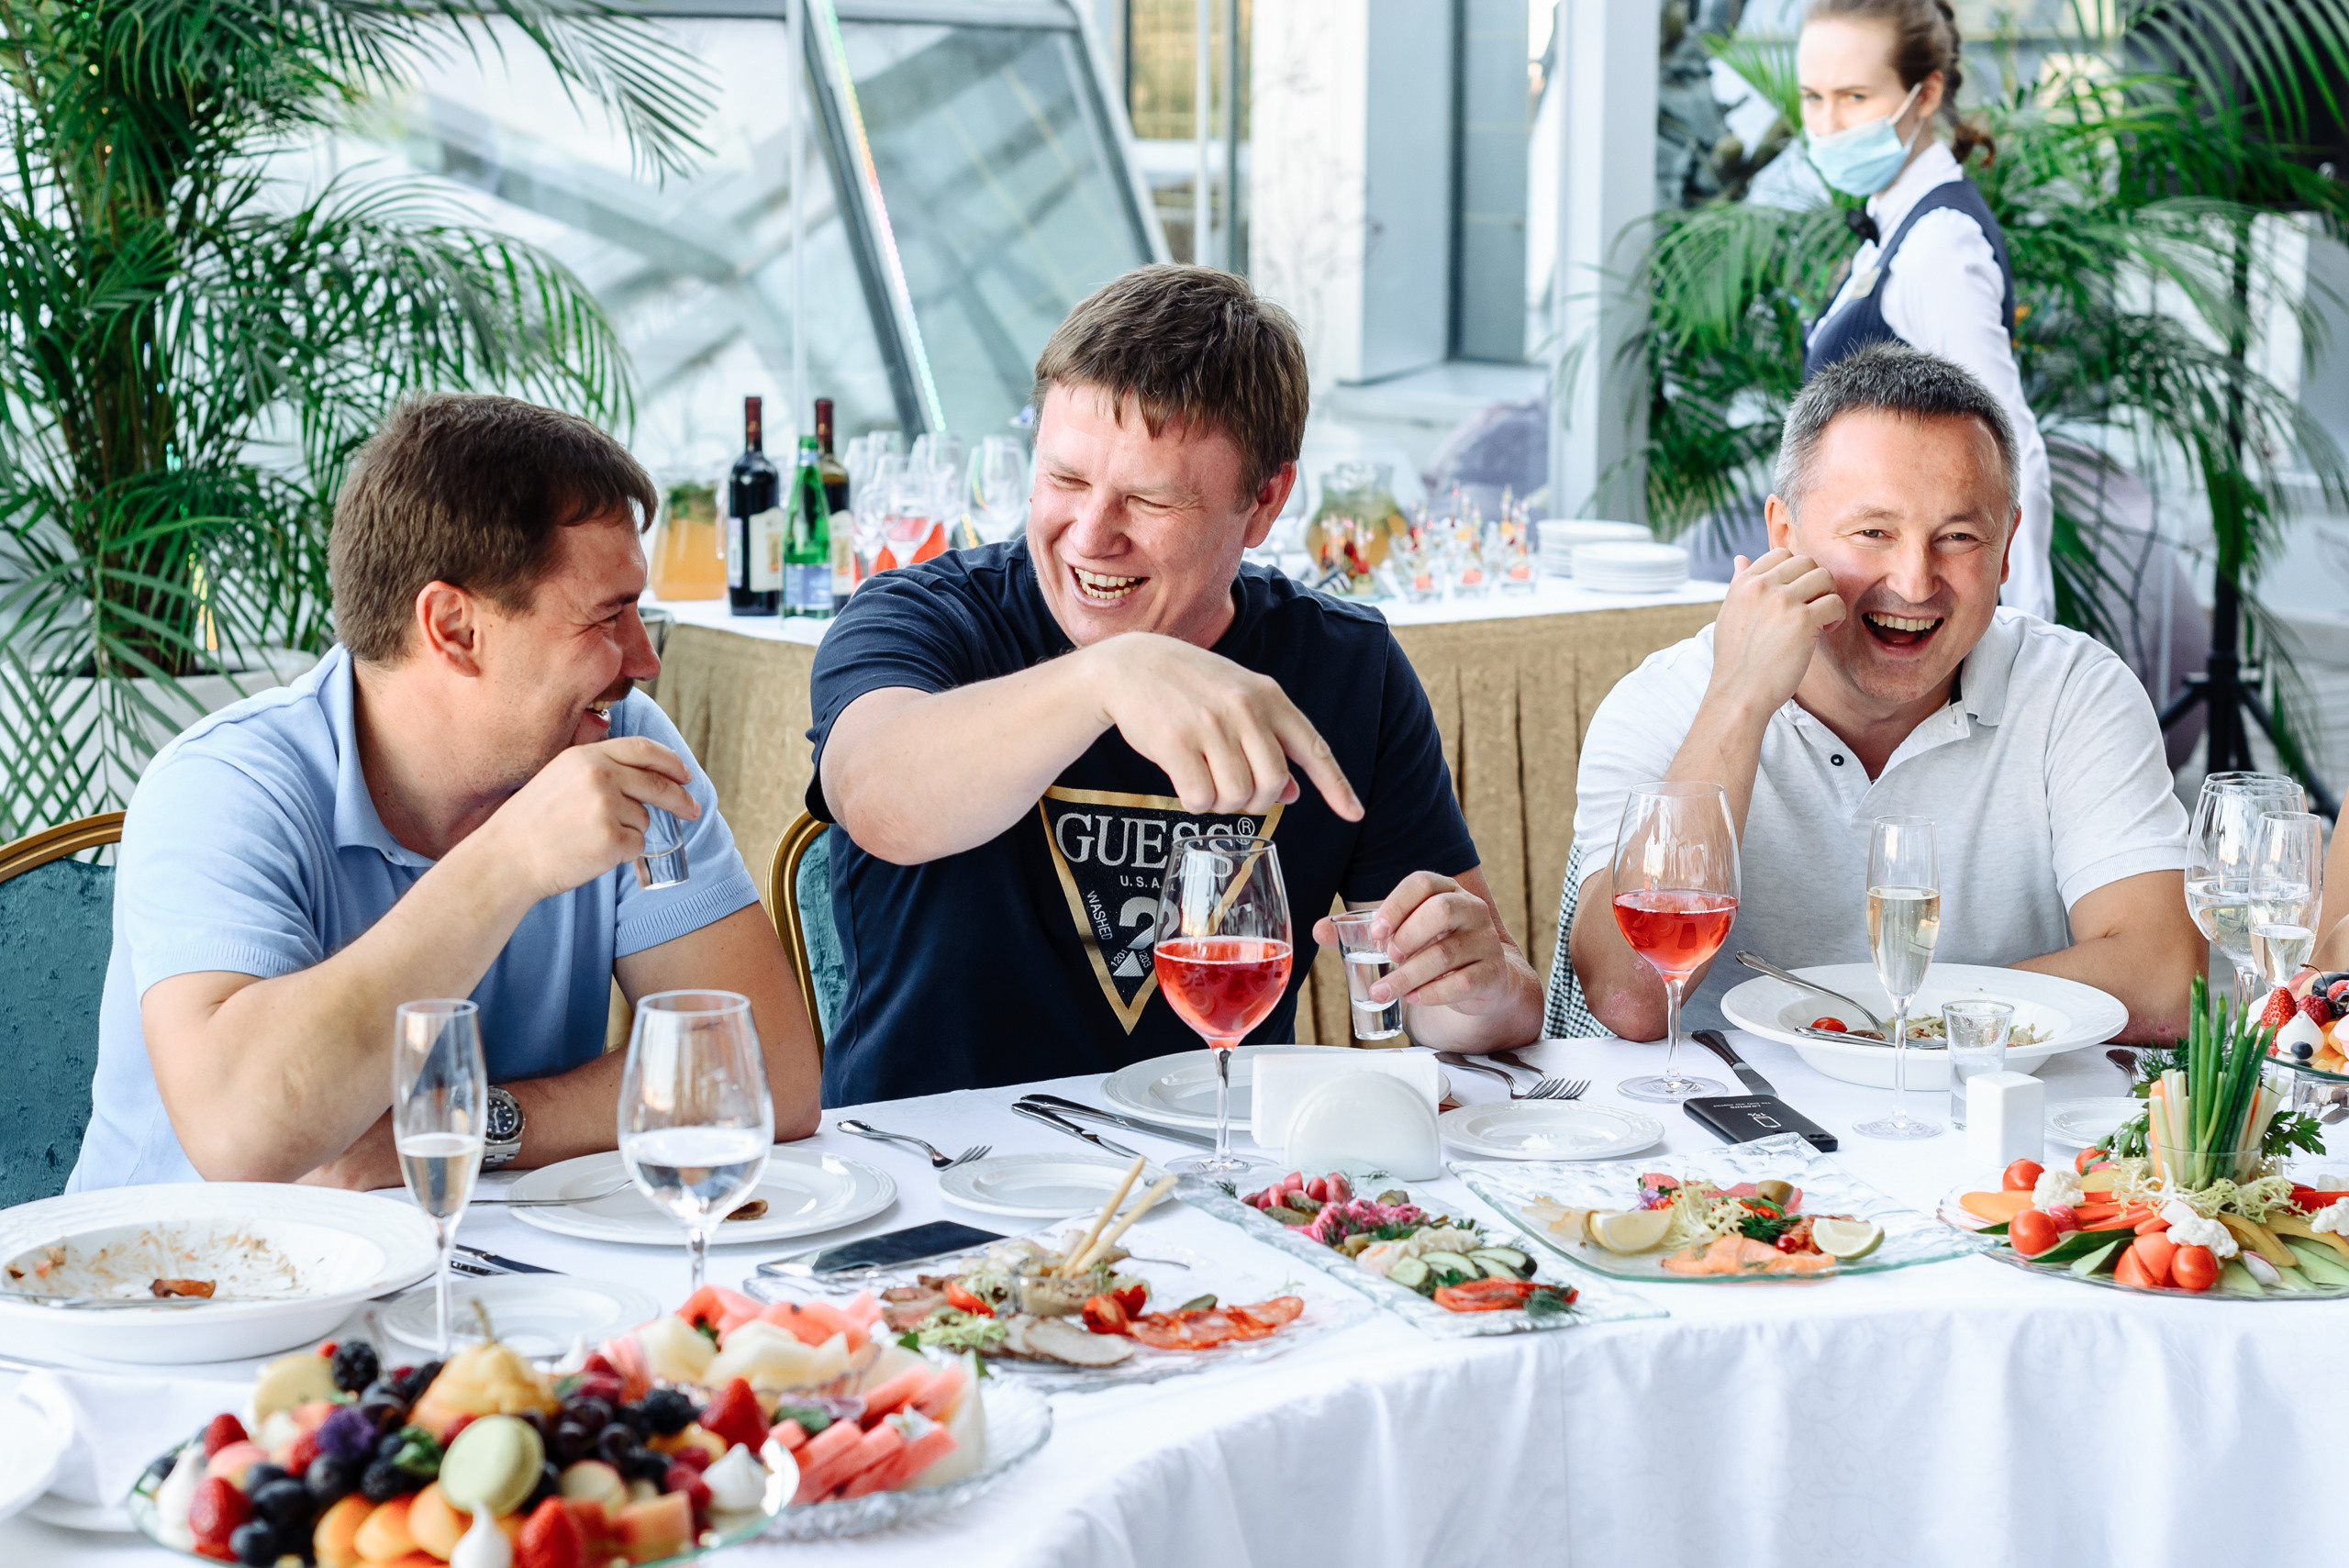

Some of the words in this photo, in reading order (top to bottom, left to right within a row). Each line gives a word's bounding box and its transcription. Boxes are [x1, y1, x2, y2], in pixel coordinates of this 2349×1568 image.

[1086, 890, 1113, 940] WASHED
[1110, 949, 1129, 967] 1201
[1138, 950, 1152, 969] 1203
